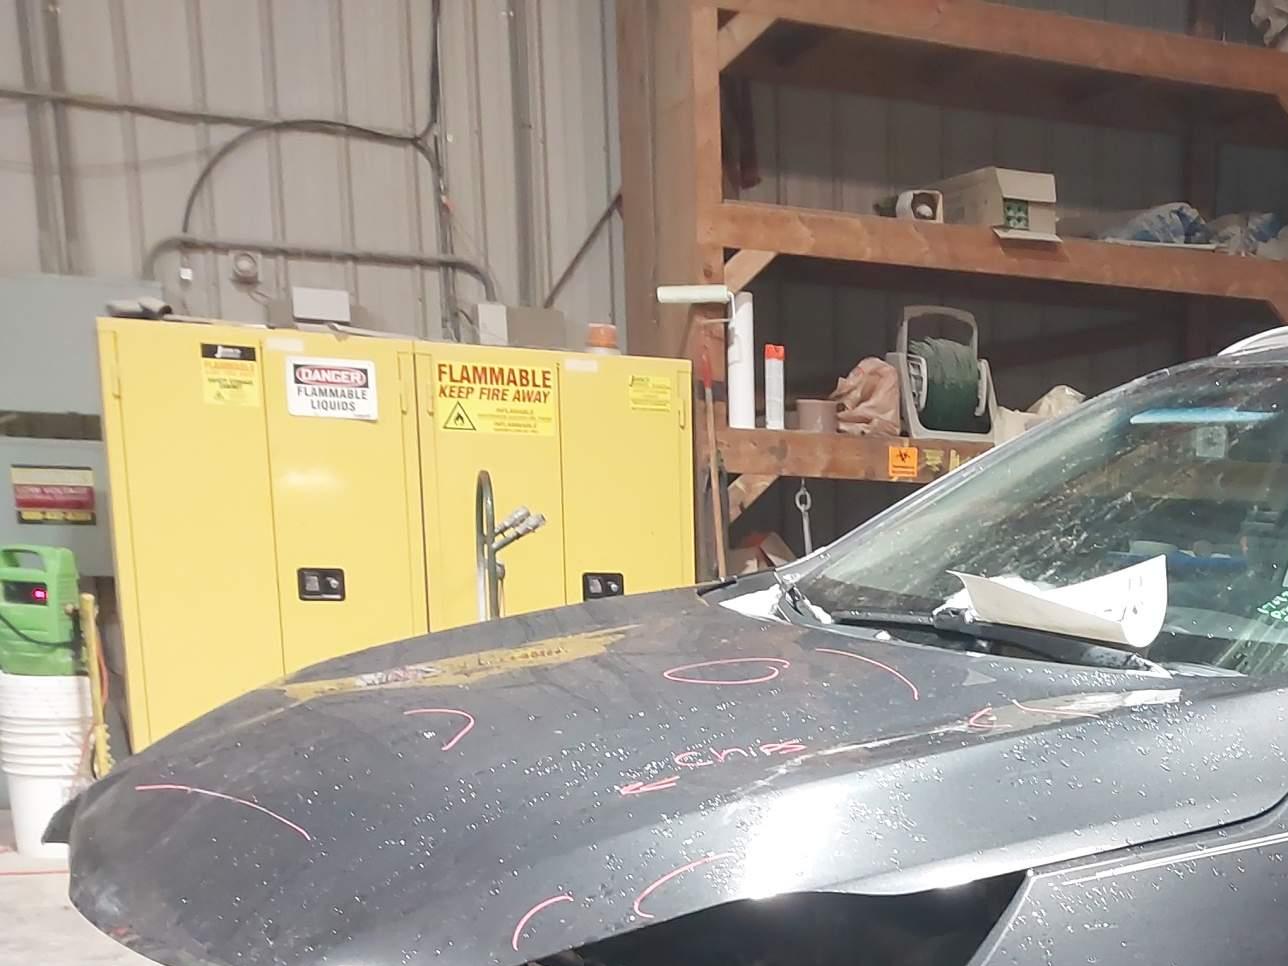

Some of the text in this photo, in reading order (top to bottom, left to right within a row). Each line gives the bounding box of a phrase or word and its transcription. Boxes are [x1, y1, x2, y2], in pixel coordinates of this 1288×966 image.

[301, 368, 362, 386] DANGER
[437, 363, 552, 388] FLAMMABLE
[297, 386, 369, 400] FLAMMABLE
[438, 384, 551, 403] KEEP FIRE AWAY
[310, 399, 356, 411] LIQUIDS
